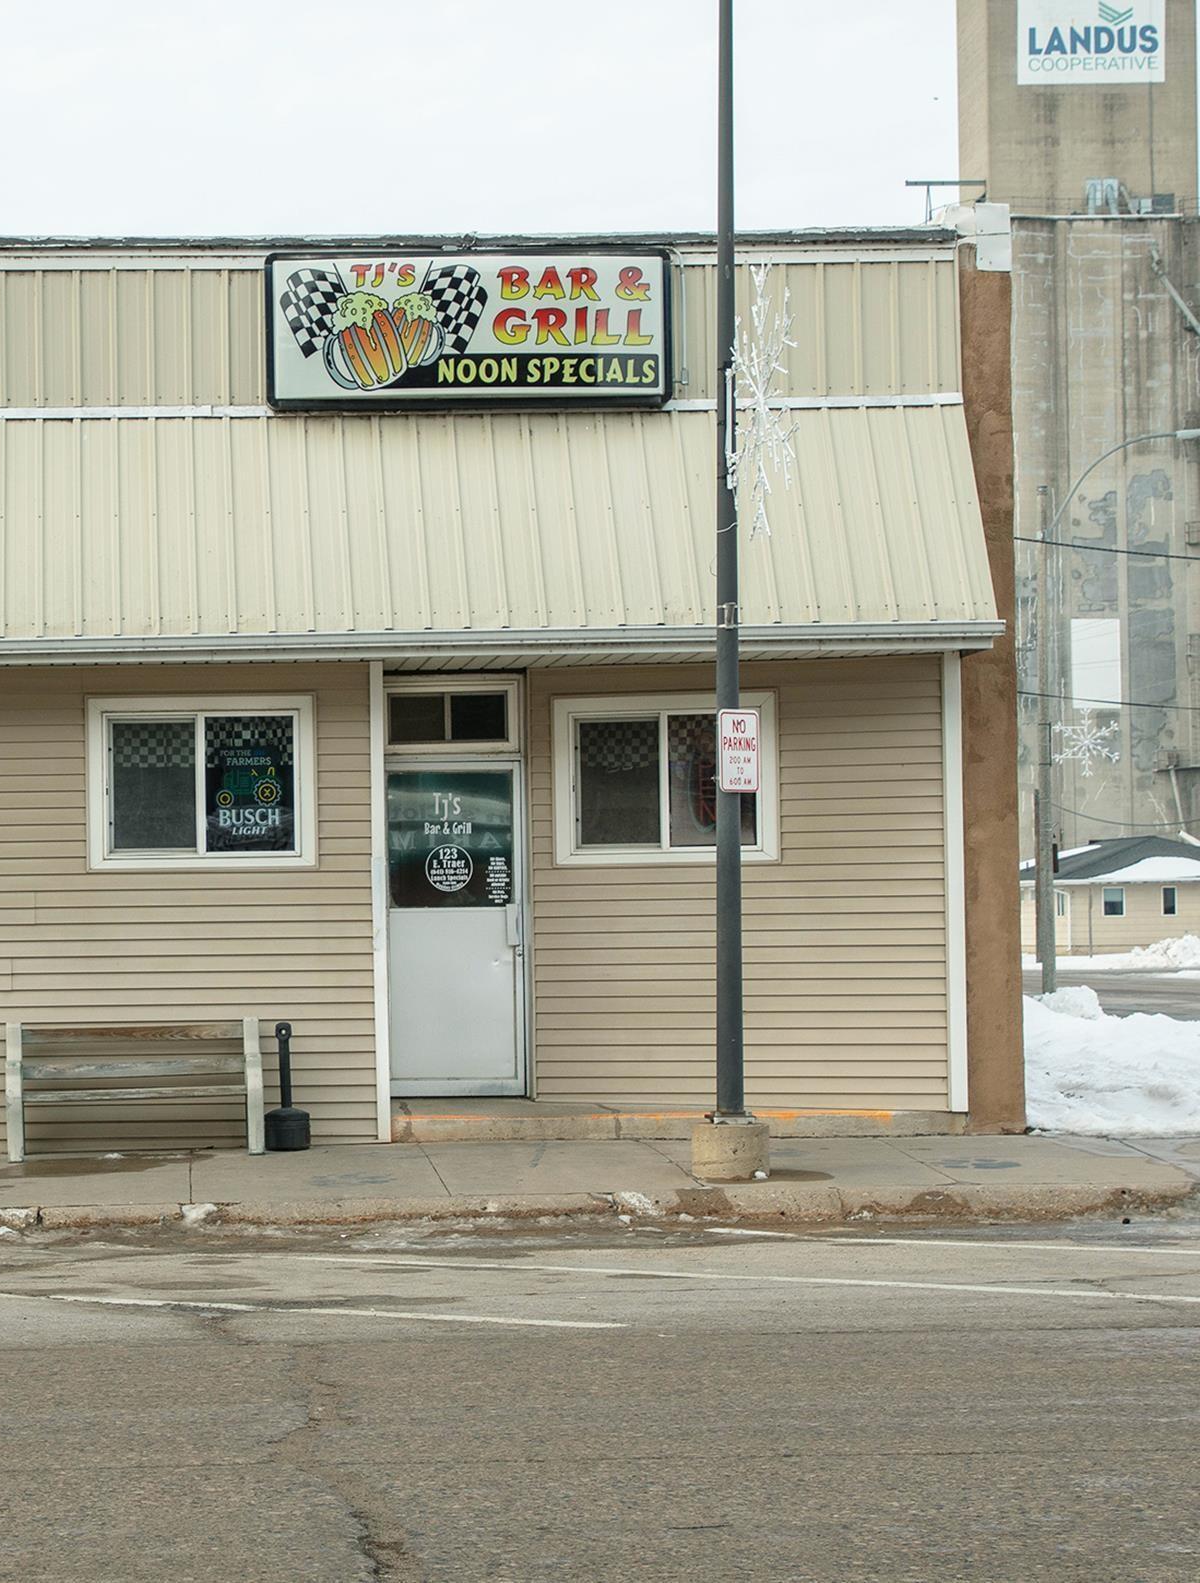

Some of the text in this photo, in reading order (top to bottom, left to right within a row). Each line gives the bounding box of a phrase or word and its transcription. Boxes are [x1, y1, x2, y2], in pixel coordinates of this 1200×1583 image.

[1028, 25, 1160, 55] LANDUS
[1028, 56, 1160, 72] COOPERATIVE
[349, 263, 416, 289] TJ'S
[496, 265, 652, 302] BAR &
[492, 307, 654, 347] GRILL
[437, 357, 656, 384] NOON SPECIALS
[732, 719, 746, 734] NO
[723, 736, 756, 752] PARKING
[237, 749, 251, 757] THE
[743, 756, 752, 764] AM
[226, 756, 272, 766] FARMERS
[737, 767, 744, 775] TO
[743, 778, 752, 786] AM
[219, 807, 280, 827] BUSCH
[231, 826, 268, 836] LIGHT
[424, 822, 472, 835] Bar & Grill
[439, 848, 458, 860] 123
[442, 859, 466, 869] Traer
